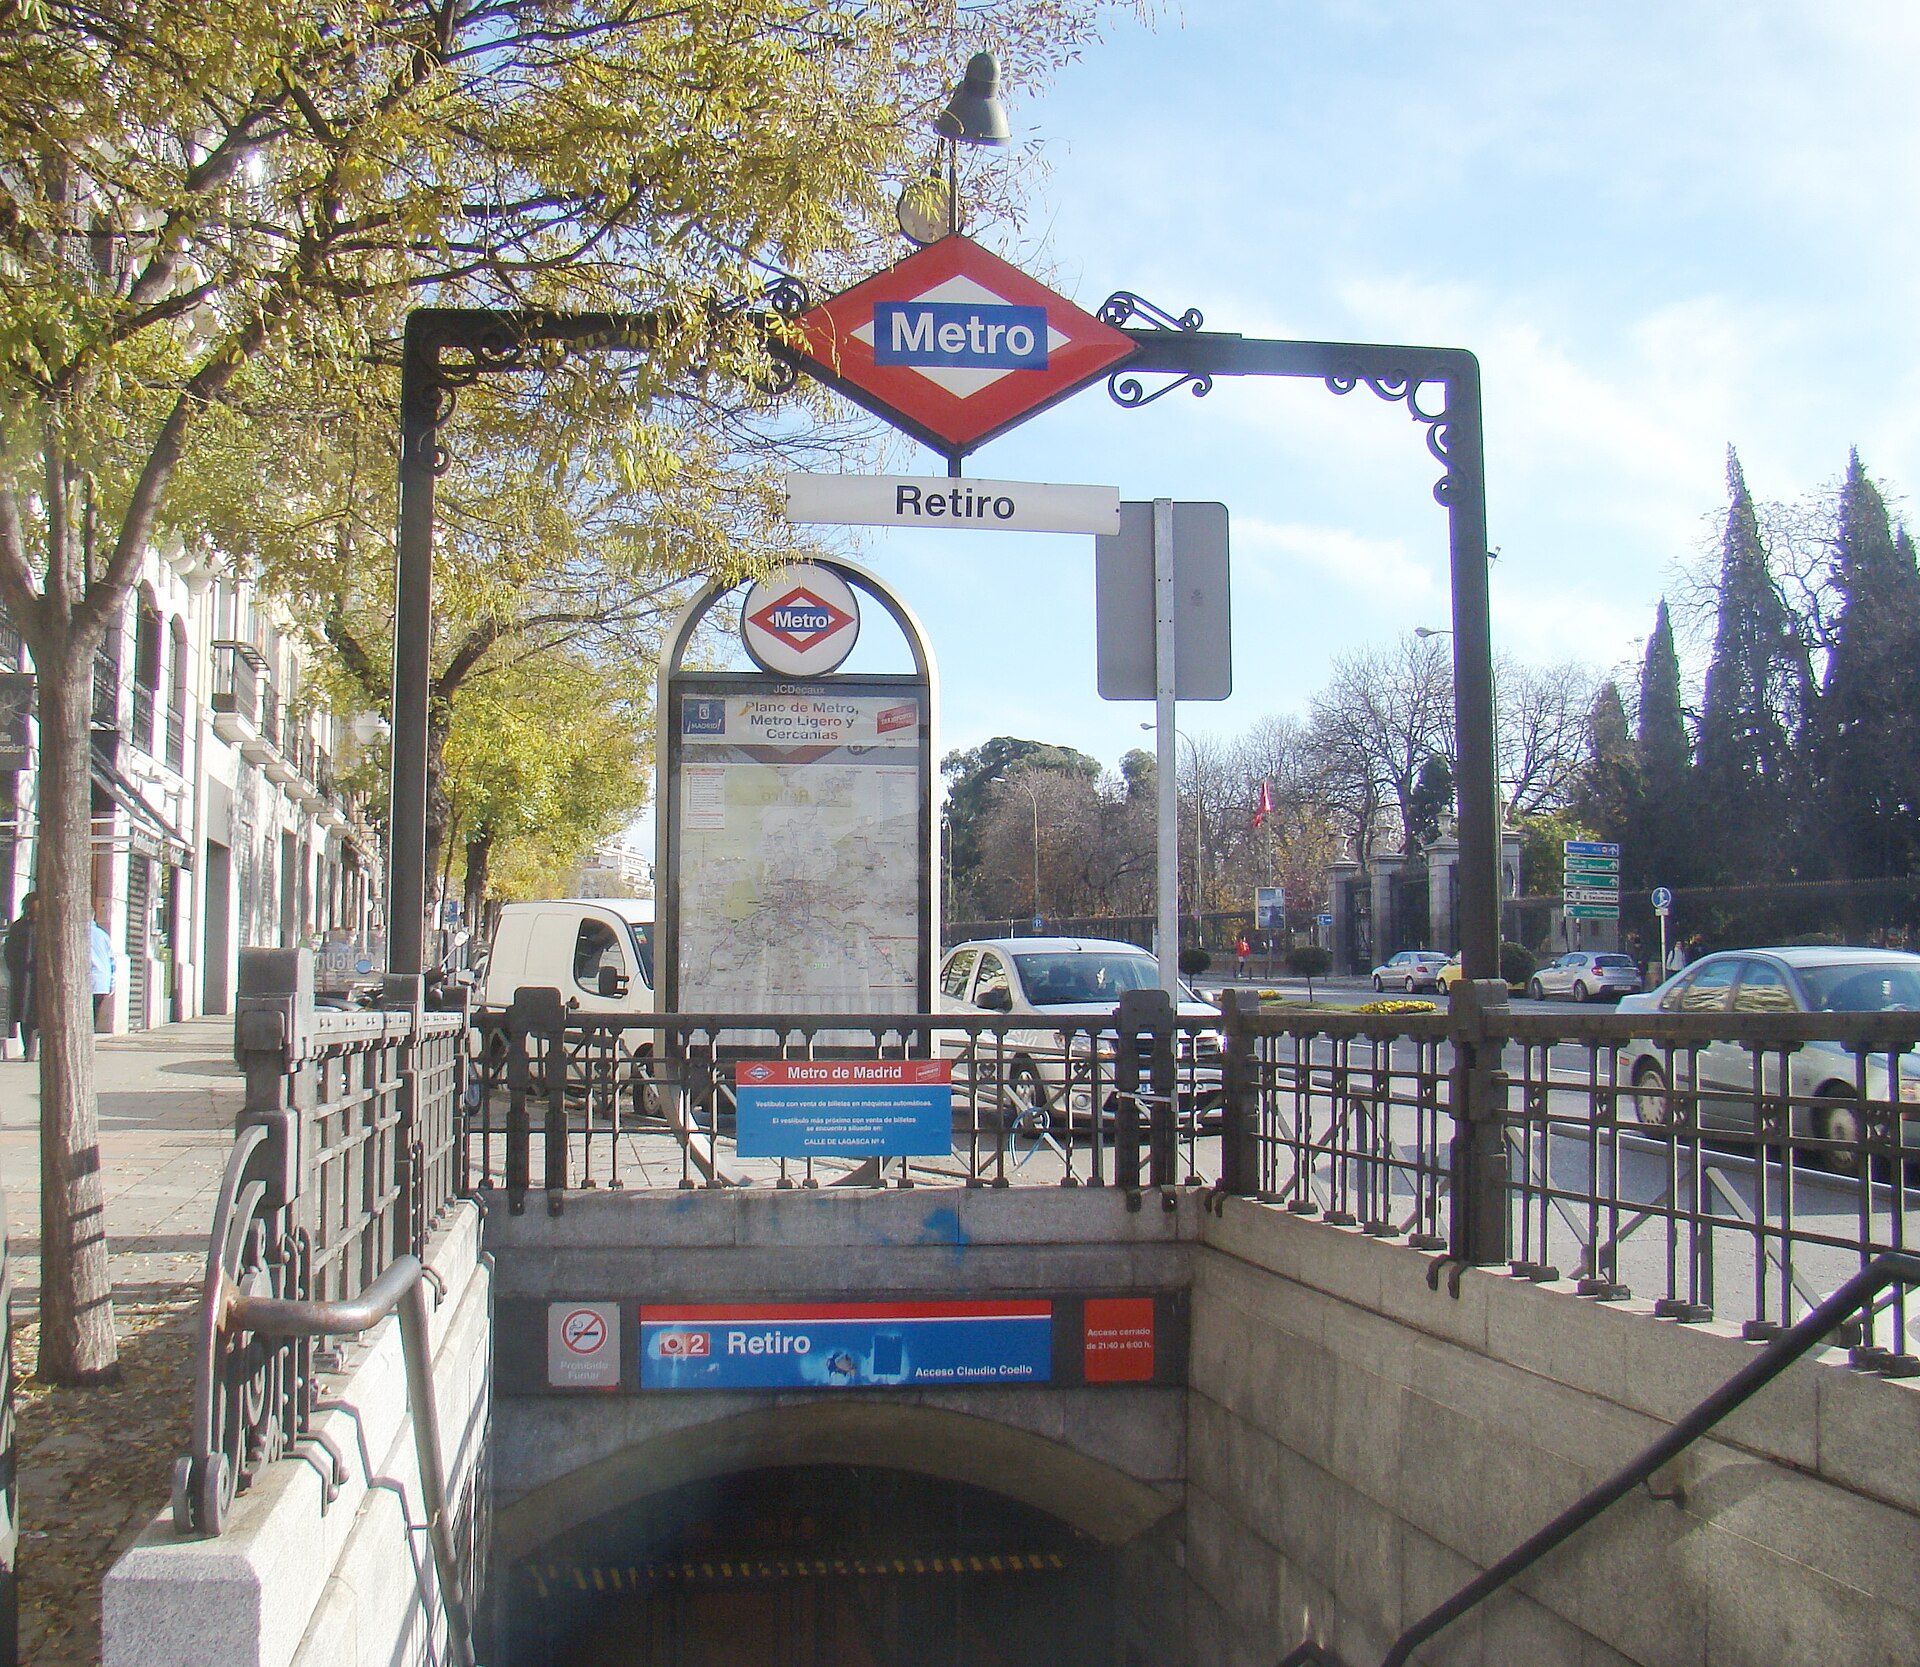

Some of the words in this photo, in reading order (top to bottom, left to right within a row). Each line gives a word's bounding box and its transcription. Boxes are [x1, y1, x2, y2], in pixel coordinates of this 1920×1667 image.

[891, 311, 1035, 356] Metro
[895, 485, 1015, 520] Retiro
[775, 611, 828, 630] Metro
[773, 684, 825, 695] JCDecaux
[792, 702, 808, 713] de
[813, 702, 859, 715] Metro,
[750, 715, 793, 726] Metro
[797, 715, 842, 729] Ligero
[846, 717, 855, 729] y
[787, 1066, 828, 1079] Metro
[832, 1066, 850, 1079] de
[854, 1066, 902, 1079] Madrid
[1087, 1328, 1118, 1337] Acceso
[1119, 1327, 1151, 1336] cerrado
[690, 1334, 704, 1353] 2
[727, 1331, 811, 1355] Retiro
[1086, 1342, 1096, 1350] de
[1098, 1341, 1118, 1349] 21:40
[560, 1359, 609, 1369] Prohibido
[915, 1367, 954, 1377] Acceso
[957, 1365, 997, 1376] Claudio
[999, 1364, 1033, 1375] Coello
[568, 1369, 600, 1379] Fumar
